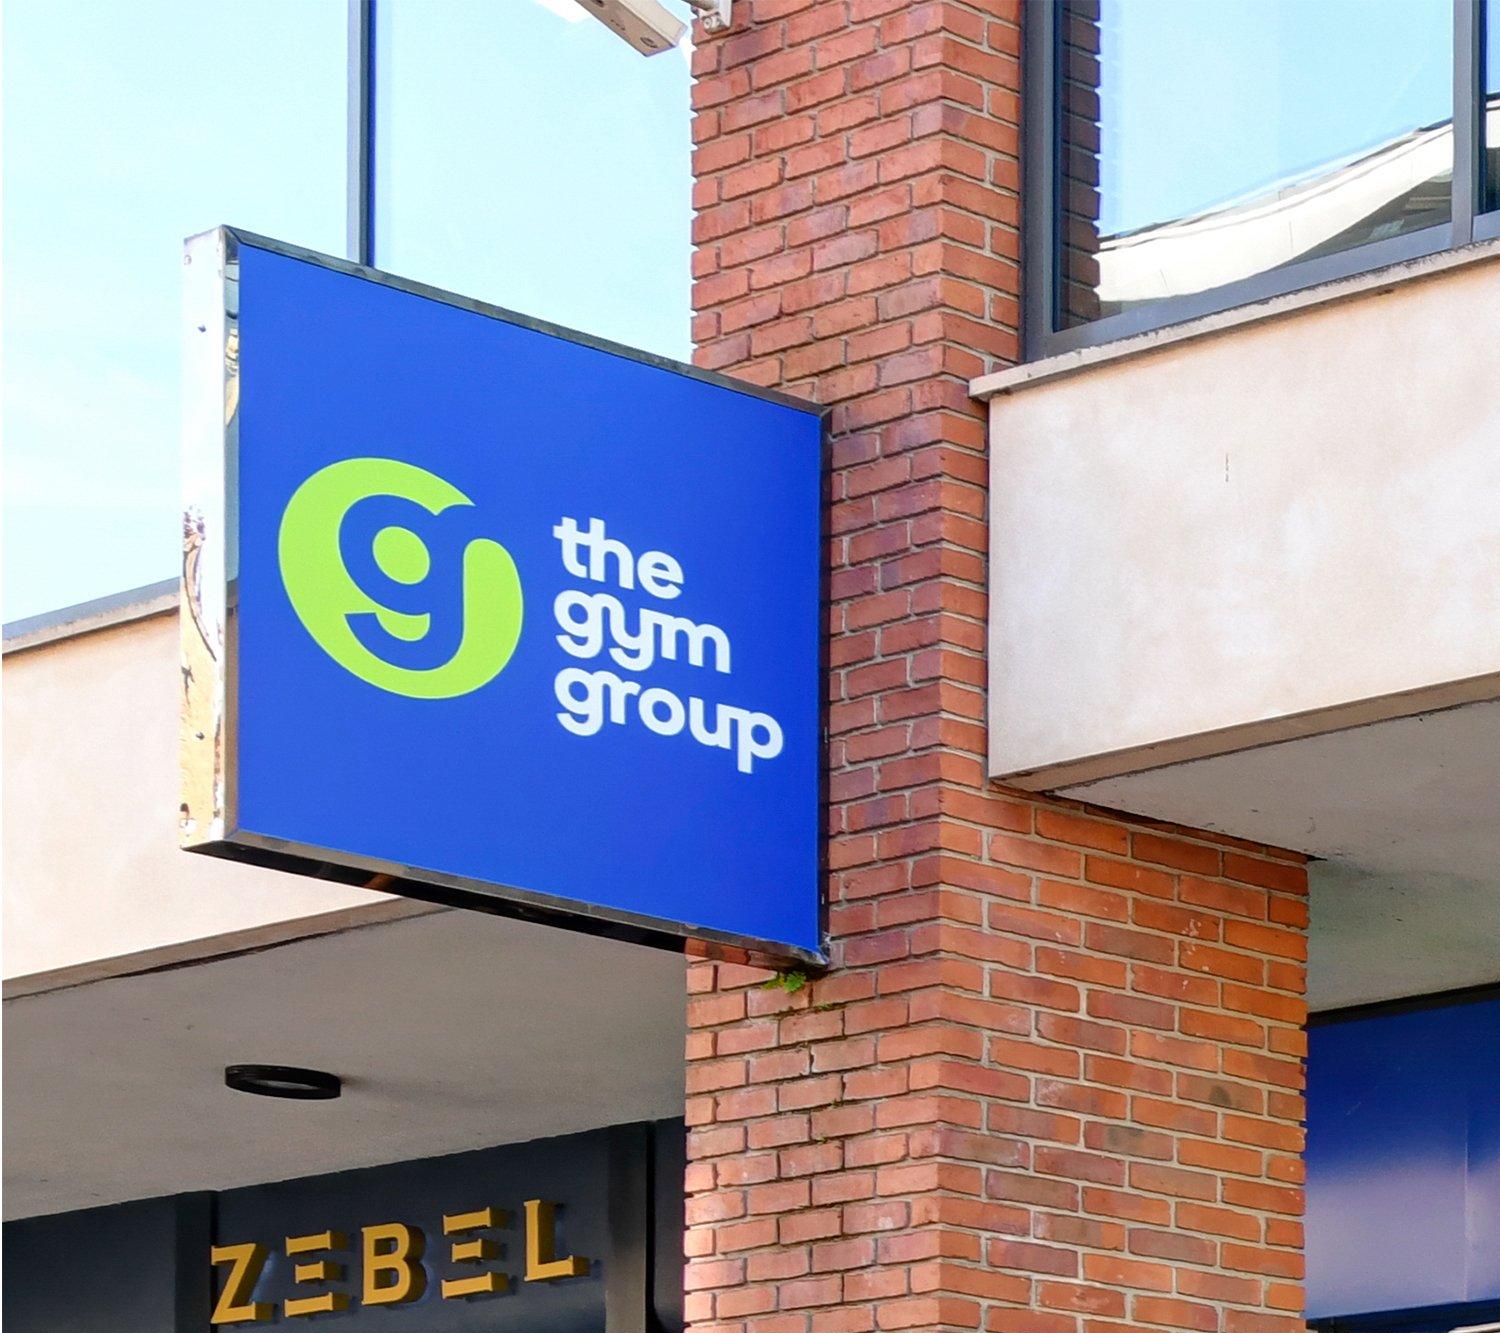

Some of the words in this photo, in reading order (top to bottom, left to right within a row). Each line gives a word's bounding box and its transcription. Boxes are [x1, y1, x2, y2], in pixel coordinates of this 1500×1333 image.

[553, 516, 684, 600] the
[554, 588, 731, 673] gym
[554, 667, 784, 773] group
[210, 1199, 580, 1324] ZEBEL
